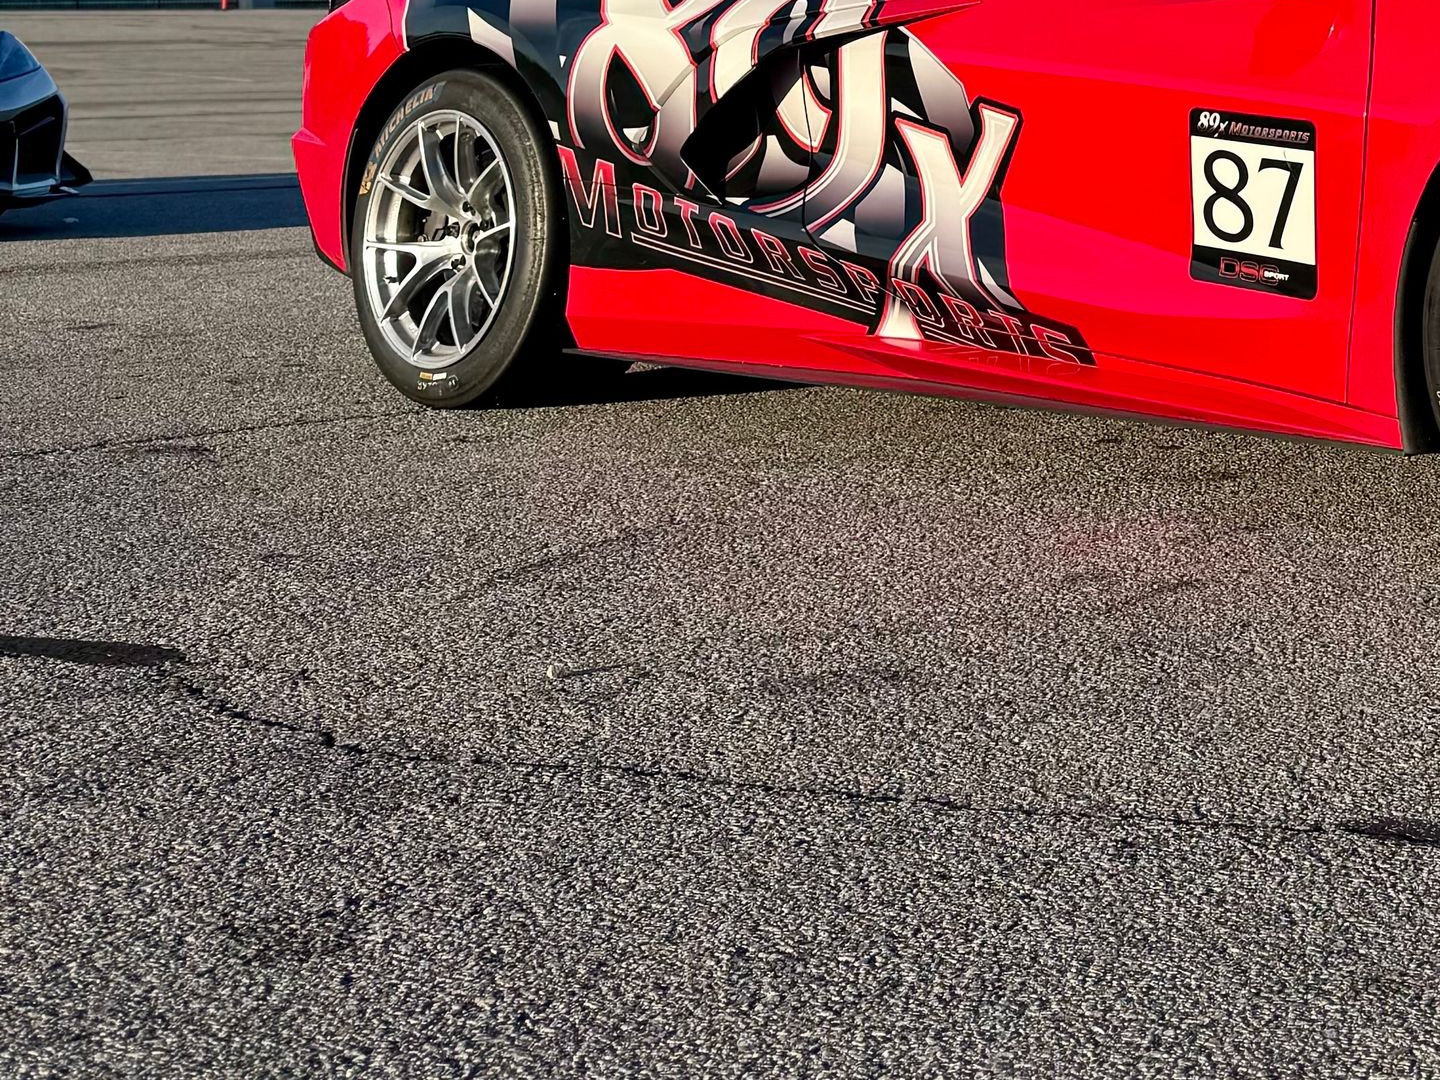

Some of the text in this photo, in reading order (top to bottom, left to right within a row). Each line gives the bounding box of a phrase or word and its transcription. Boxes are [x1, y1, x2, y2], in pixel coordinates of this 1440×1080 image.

[374, 86, 435, 159] MICHELIN
[1229, 121, 1311, 144] MOTORSPORTS
[1203, 149, 1304, 250] 87
[1218, 256, 1290, 286] DSC SPORT
